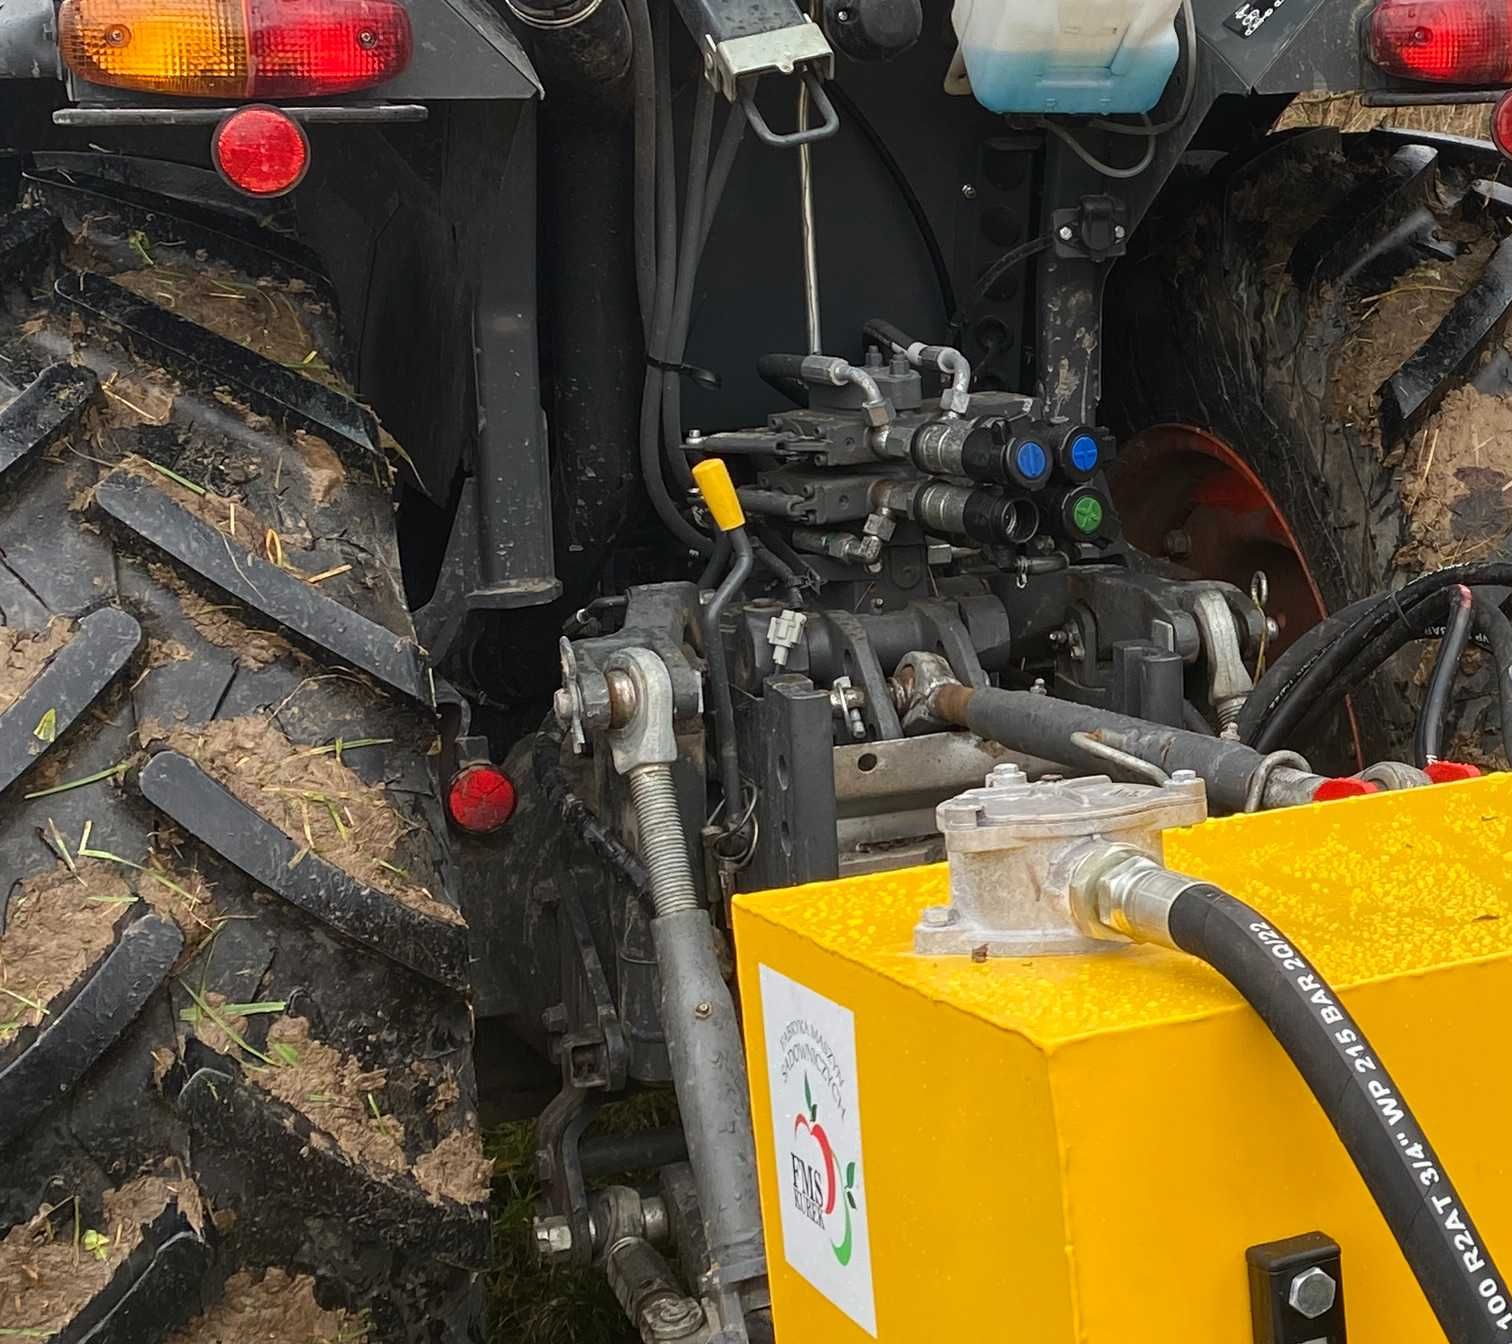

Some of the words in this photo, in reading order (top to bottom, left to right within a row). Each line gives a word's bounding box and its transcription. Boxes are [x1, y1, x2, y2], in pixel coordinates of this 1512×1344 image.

[1297, 973, 1343, 1025] BAR
[1334, 1028, 1378, 1074] 215
[1367, 1080, 1404, 1127] WP
[790, 1151, 825, 1207] FMS
[1396, 1131, 1442, 1187] 3/4"
[793, 1188, 826, 1231] KUREK
[1430, 1194, 1487, 1274] R2AT
